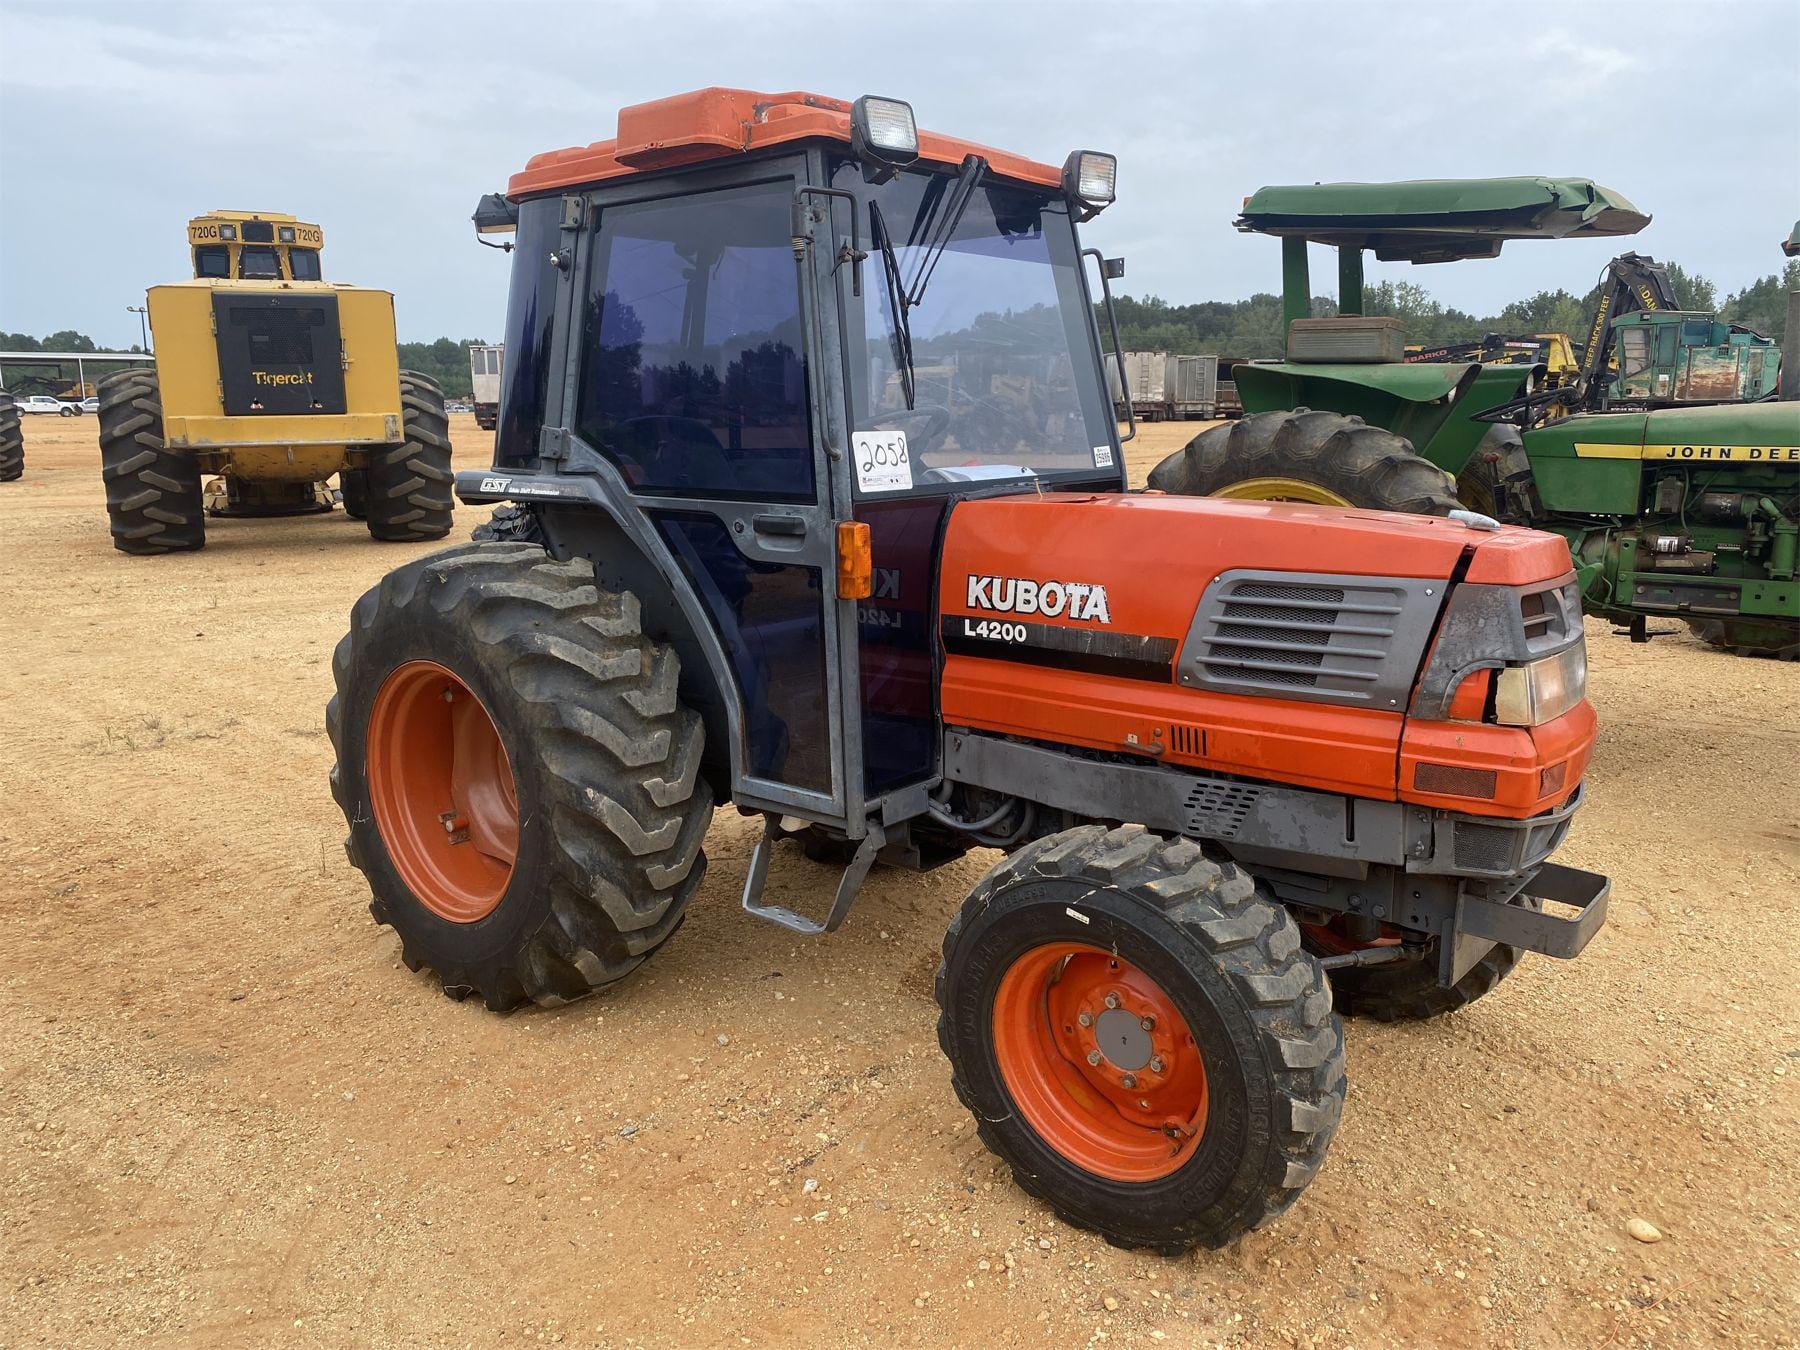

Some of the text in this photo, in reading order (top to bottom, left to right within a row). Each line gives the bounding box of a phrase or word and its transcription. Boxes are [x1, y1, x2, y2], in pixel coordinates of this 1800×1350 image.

[191, 226, 217, 238] 720G
[297, 228, 320, 241] 720G
[1584, 347, 1595, 367] KEEP
[1590, 325, 1602, 347] BACK
[1600, 295, 1610, 312] FEET
[1410, 350, 1448, 362] BARKO
[860, 437, 908, 473] 2058
[1666, 447, 1732, 459] JOHN
[480, 478, 513, 493] GST
[966, 574, 1111, 625] KUBOTA
[964, 619, 1027, 642] L4200
